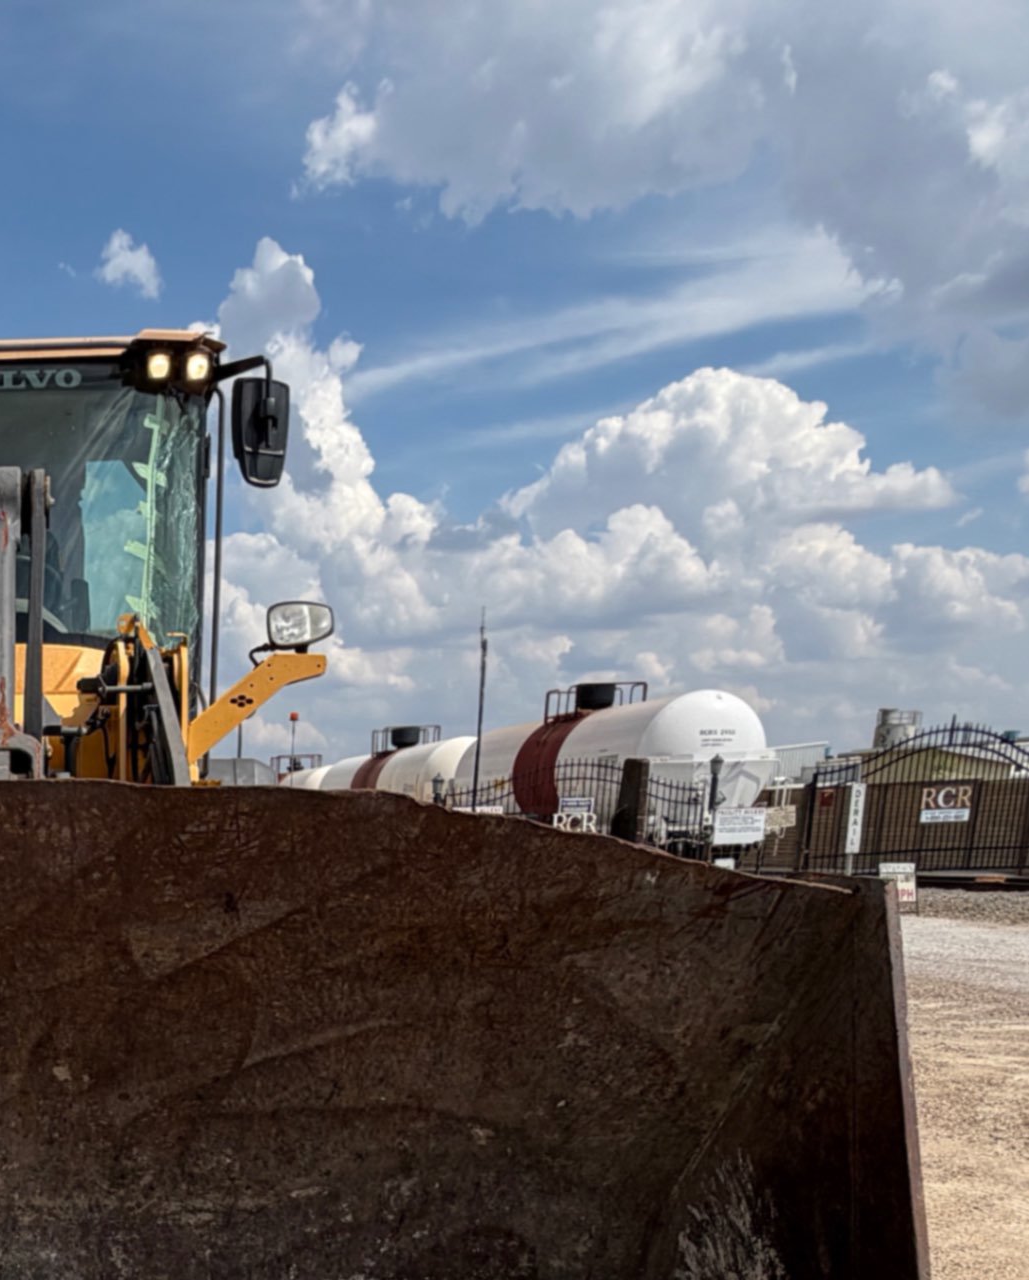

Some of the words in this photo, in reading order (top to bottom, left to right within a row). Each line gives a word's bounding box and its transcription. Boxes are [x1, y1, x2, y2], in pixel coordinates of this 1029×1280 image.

[920, 785, 972, 809] RCR
[553, 812, 597, 833] RCR
[850, 788, 862, 846] DERAIL
